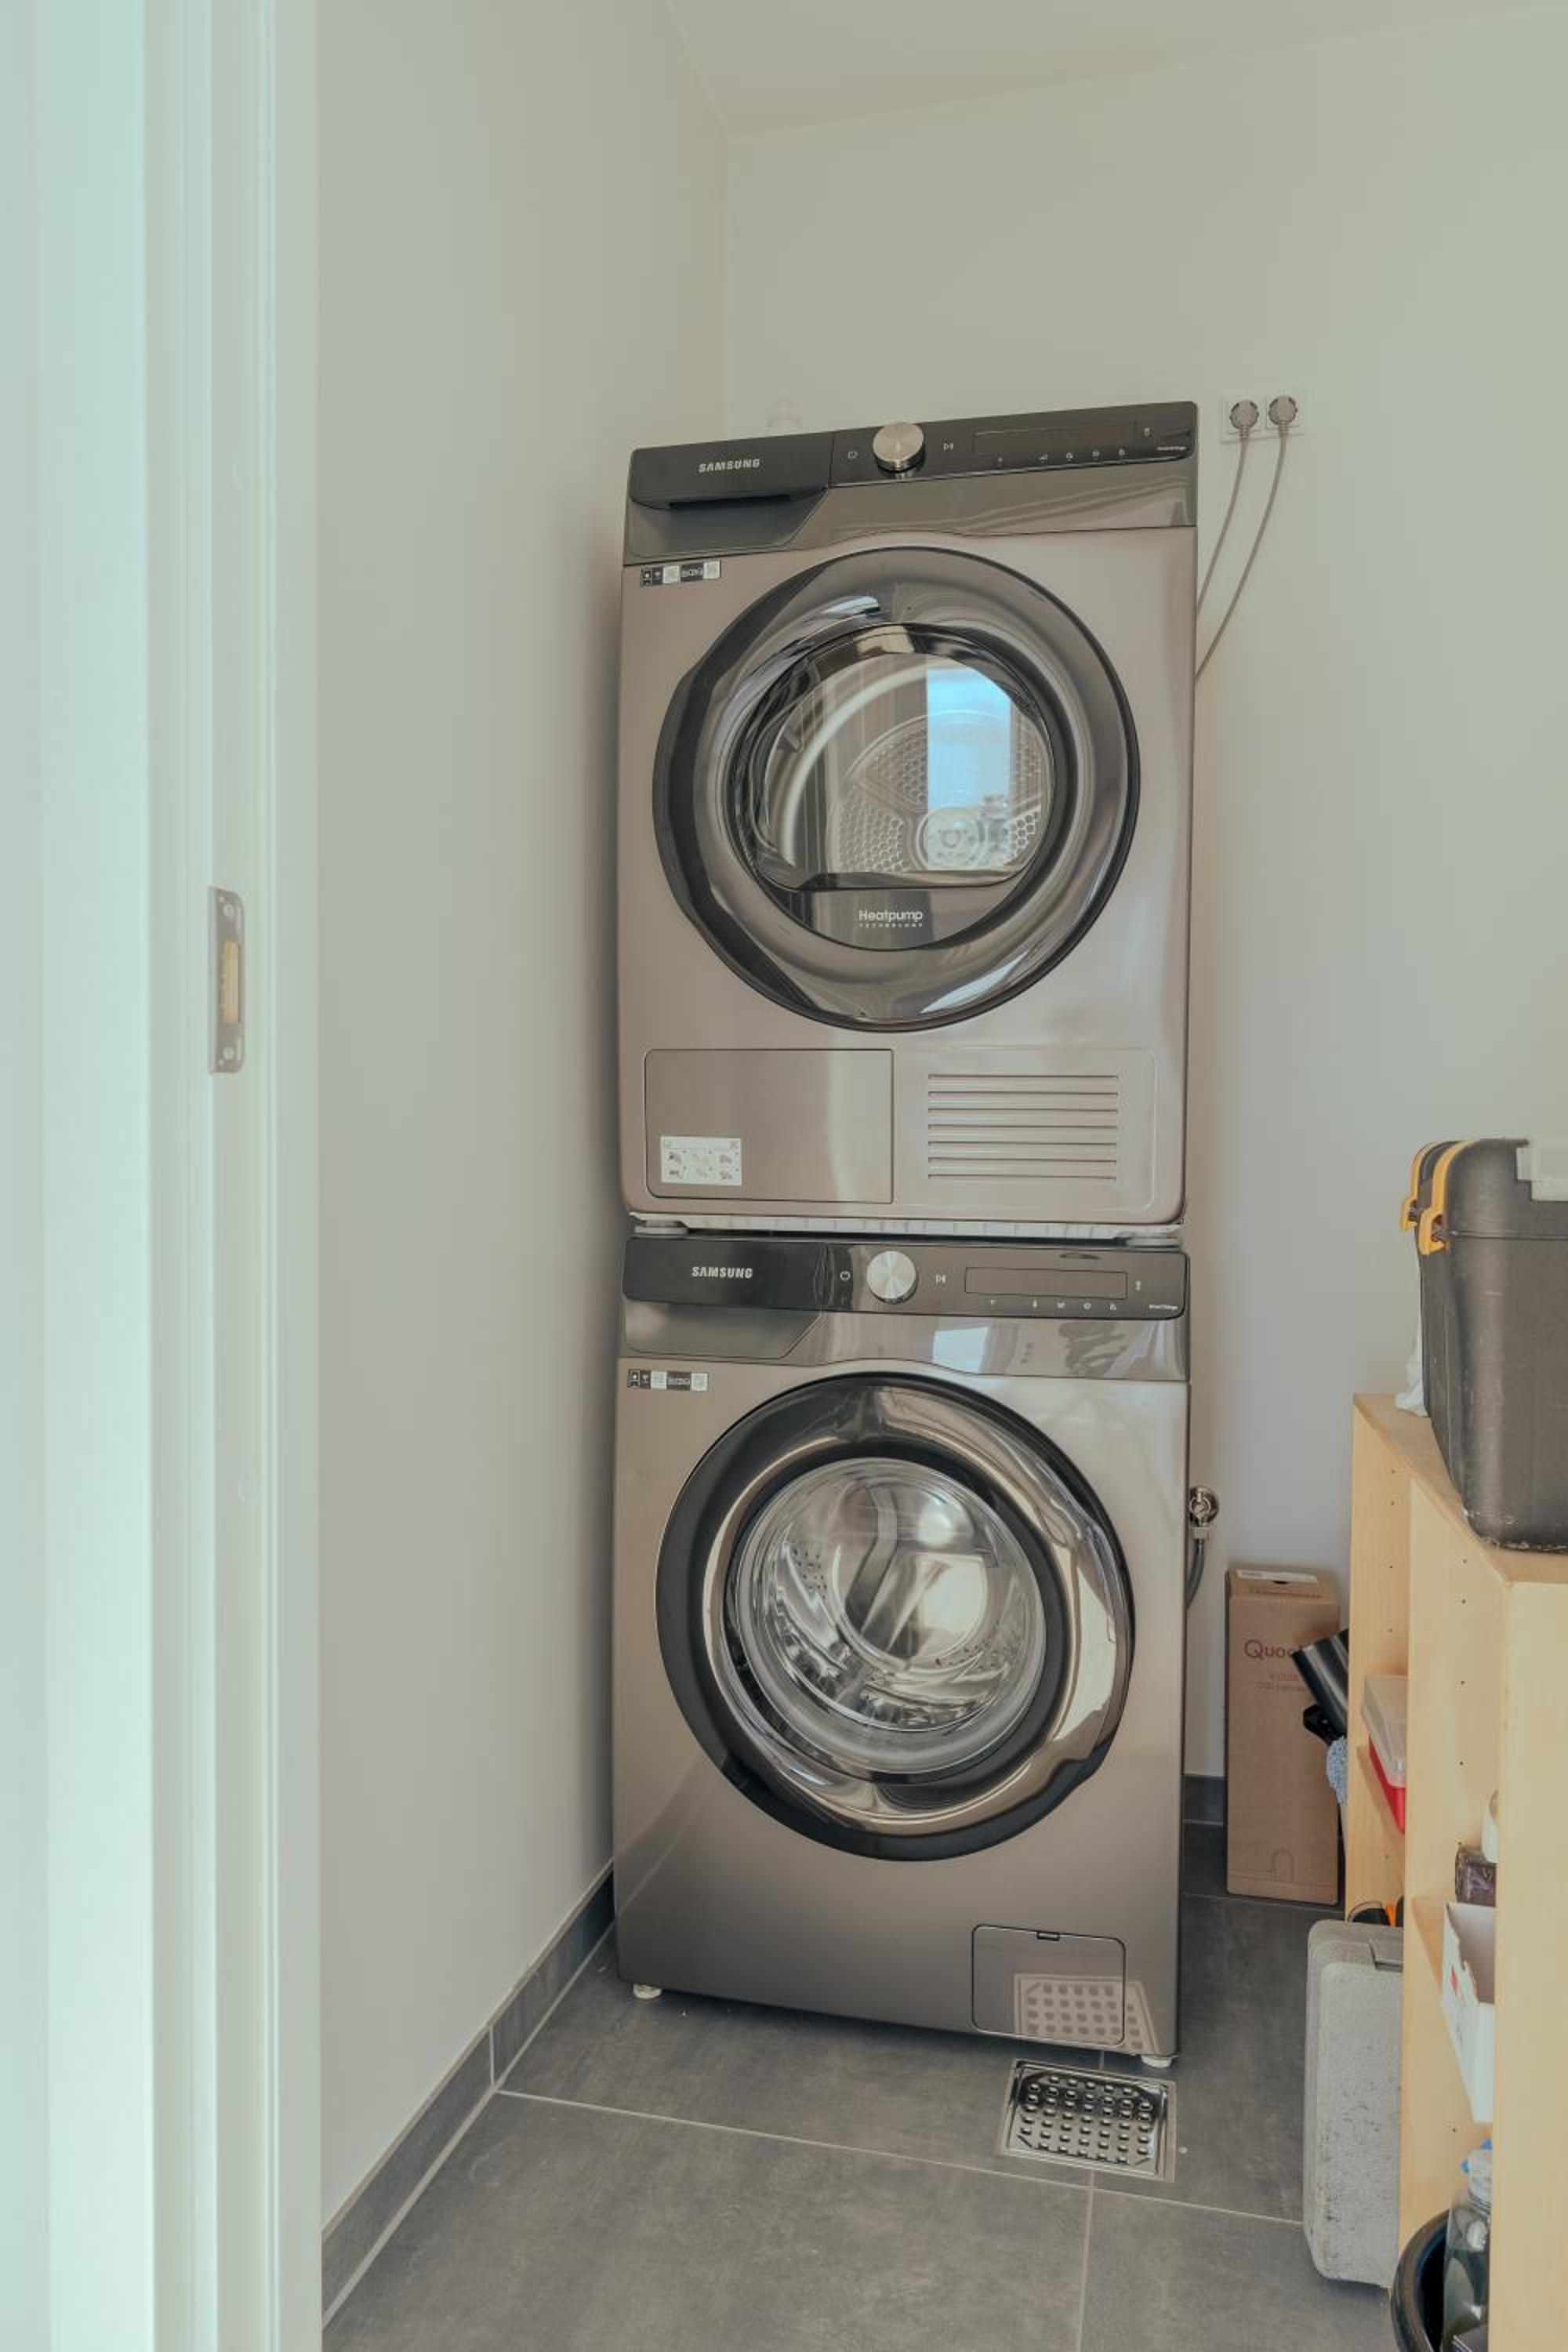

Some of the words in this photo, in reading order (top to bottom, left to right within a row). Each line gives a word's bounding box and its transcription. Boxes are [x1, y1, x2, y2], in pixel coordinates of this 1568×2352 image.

[699, 458, 760, 474] SAMSUNG
[858, 909, 924, 923] Heatpump
[691, 1266, 753, 1279] SAMSUNG
